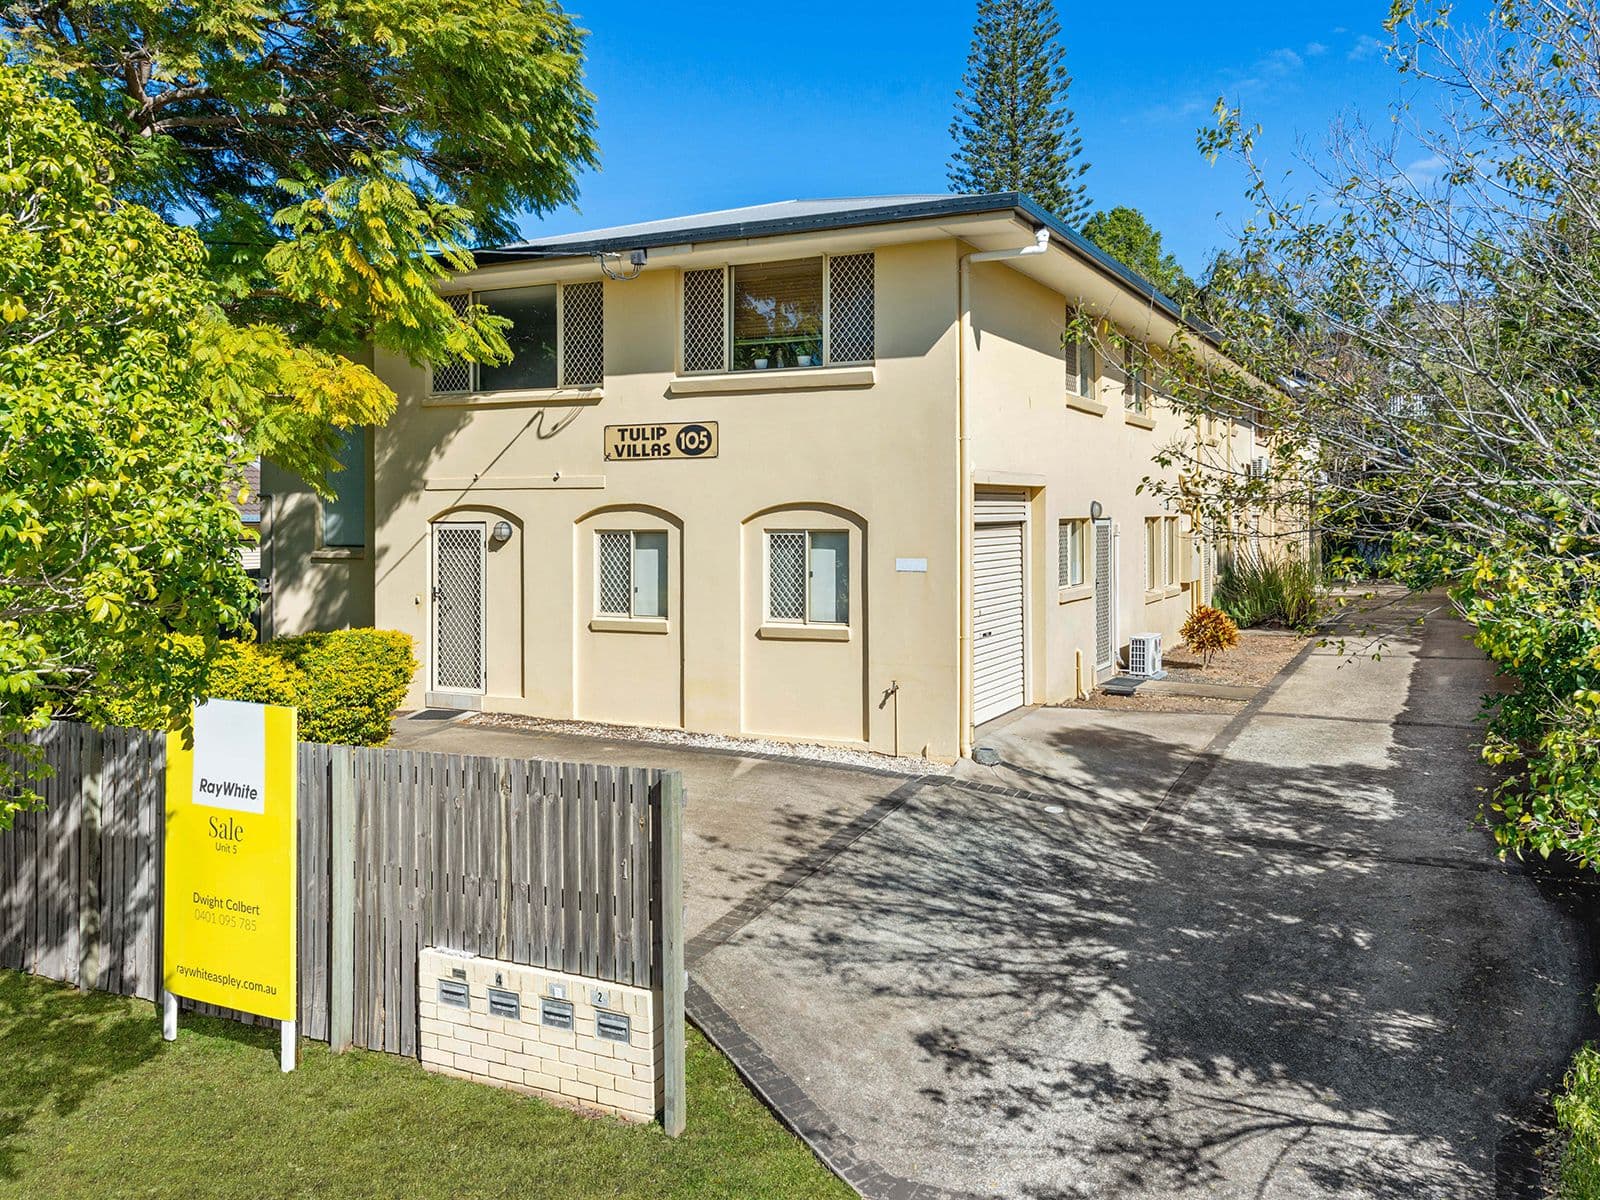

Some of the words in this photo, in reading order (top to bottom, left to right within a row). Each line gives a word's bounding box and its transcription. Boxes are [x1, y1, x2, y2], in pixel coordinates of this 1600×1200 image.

[617, 427, 667, 442] TULIP
[680, 431, 708, 450] 105
[614, 443, 671, 458] VILLAS
[199, 778, 258, 800] RayWhite
[209, 816, 244, 842] Sale
[216, 842, 230, 853] Unit
[232, 845, 238, 854] 5
[193, 892, 223, 909] Dwight
[226, 899, 260, 915] Colbert
[194, 908, 216, 924] 0401
[218, 912, 237, 928] 095
[239, 916, 257, 932] 785
[176, 964, 277, 995] raywhiteaspley.com.au
[496, 973, 503, 986] 4
[596, 992, 603, 1003] 2
